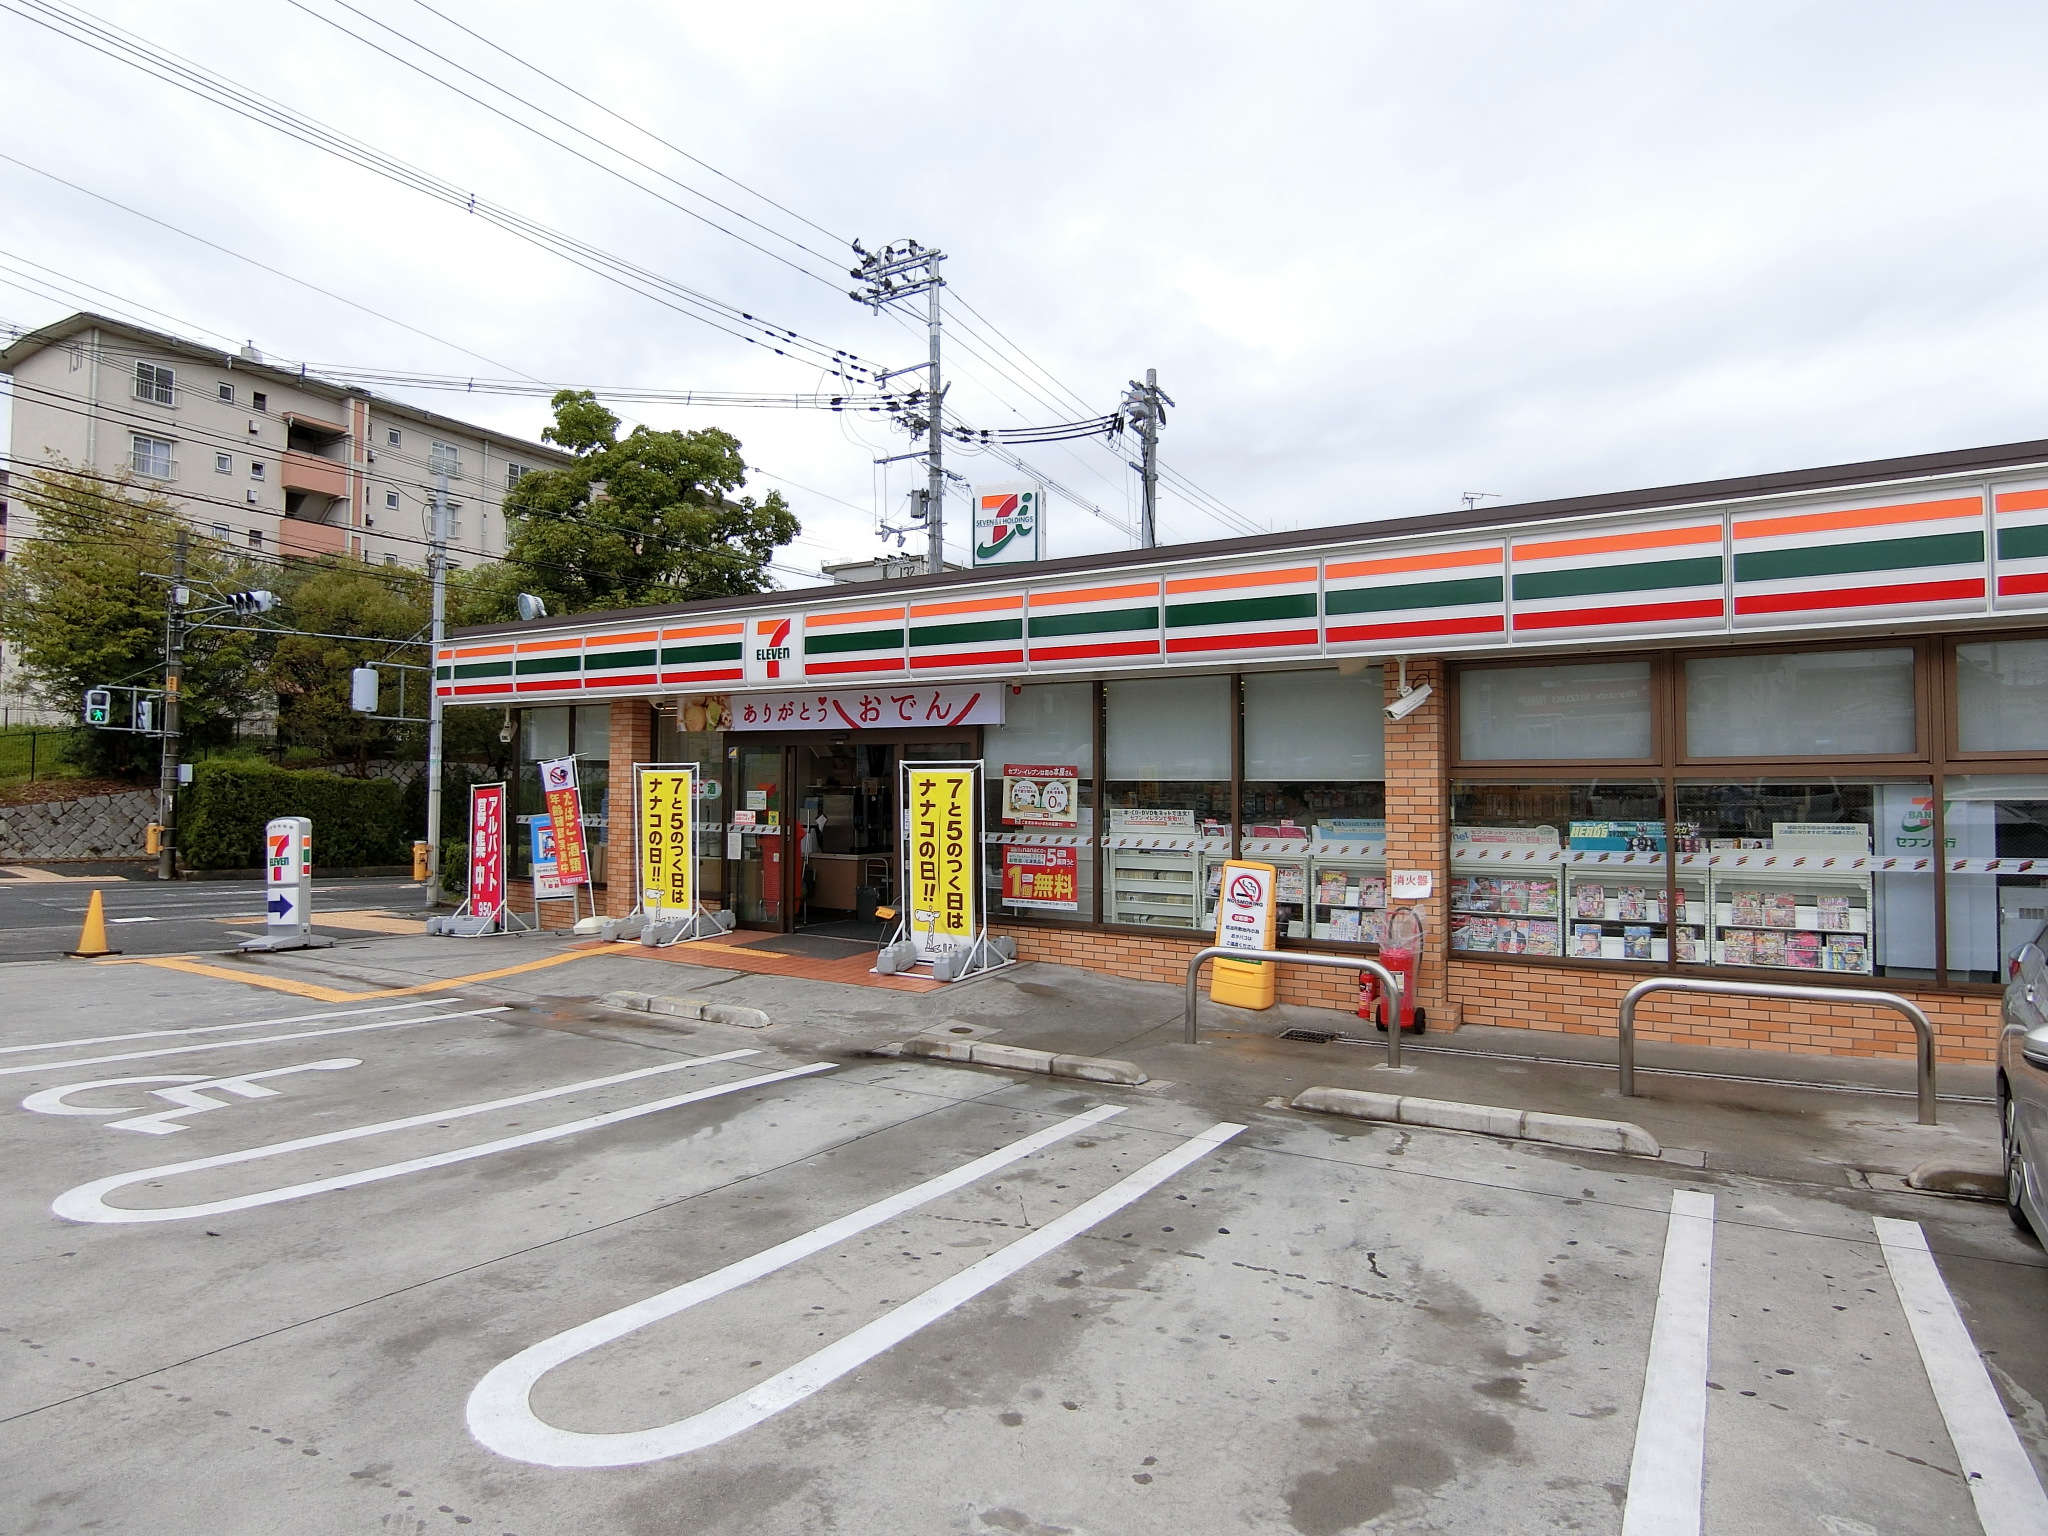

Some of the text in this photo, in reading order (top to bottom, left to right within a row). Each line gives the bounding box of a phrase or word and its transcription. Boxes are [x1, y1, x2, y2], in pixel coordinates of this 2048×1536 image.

[1002, 515, 1034, 524] HOLDINGS
[858, 690, 952, 723] おでん
[1908, 811, 1933, 819] BAN
[475, 798, 487, 892] 募集中
[487, 796, 499, 892] アルバイト
[670, 777, 685, 904] 7と5のつく日は
[1895, 837, 1957, 848] セブン行
[946, 778, 964, 929] 7と5のつく日は
[1393, 874, 1429, 887] 消火器
[1236, 899, 1264, 908] SMOKING
